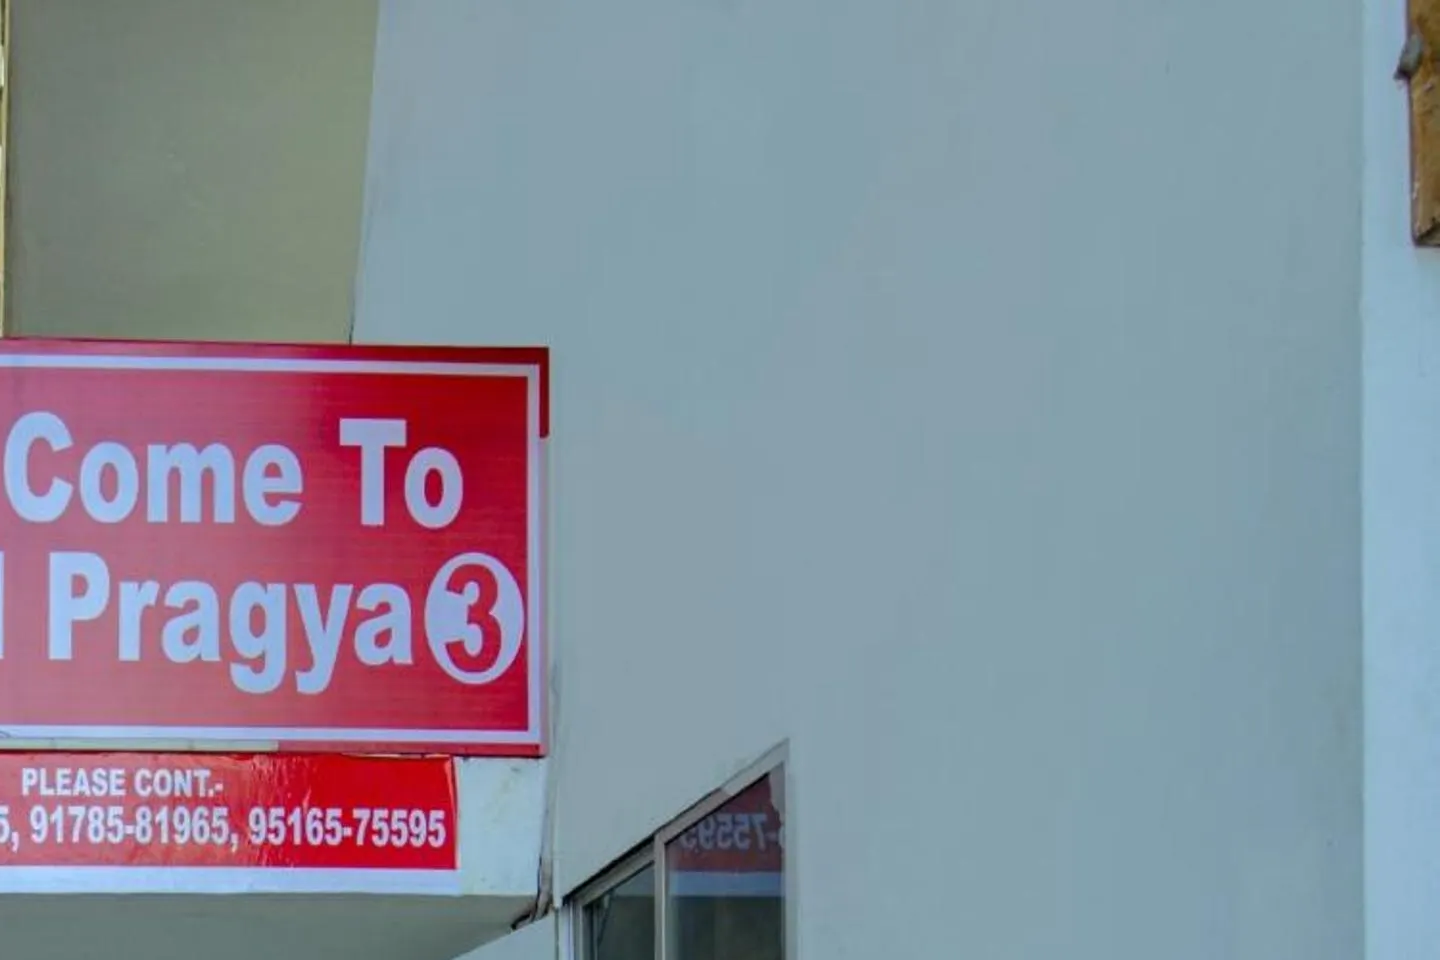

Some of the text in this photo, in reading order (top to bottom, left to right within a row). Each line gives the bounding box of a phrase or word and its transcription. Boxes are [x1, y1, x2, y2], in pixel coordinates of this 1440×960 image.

[3, 411, 304, 525] Come
[339, 417, 464, 529] To
[48, 551, 414, 694] Pragya
[437, 558, 511, 678] 3
[21, 767, 126, 797] PLEASE
[29, 806, 239, 853] 91785-81965,
[248, 807, 447, 848] 95165-75595
